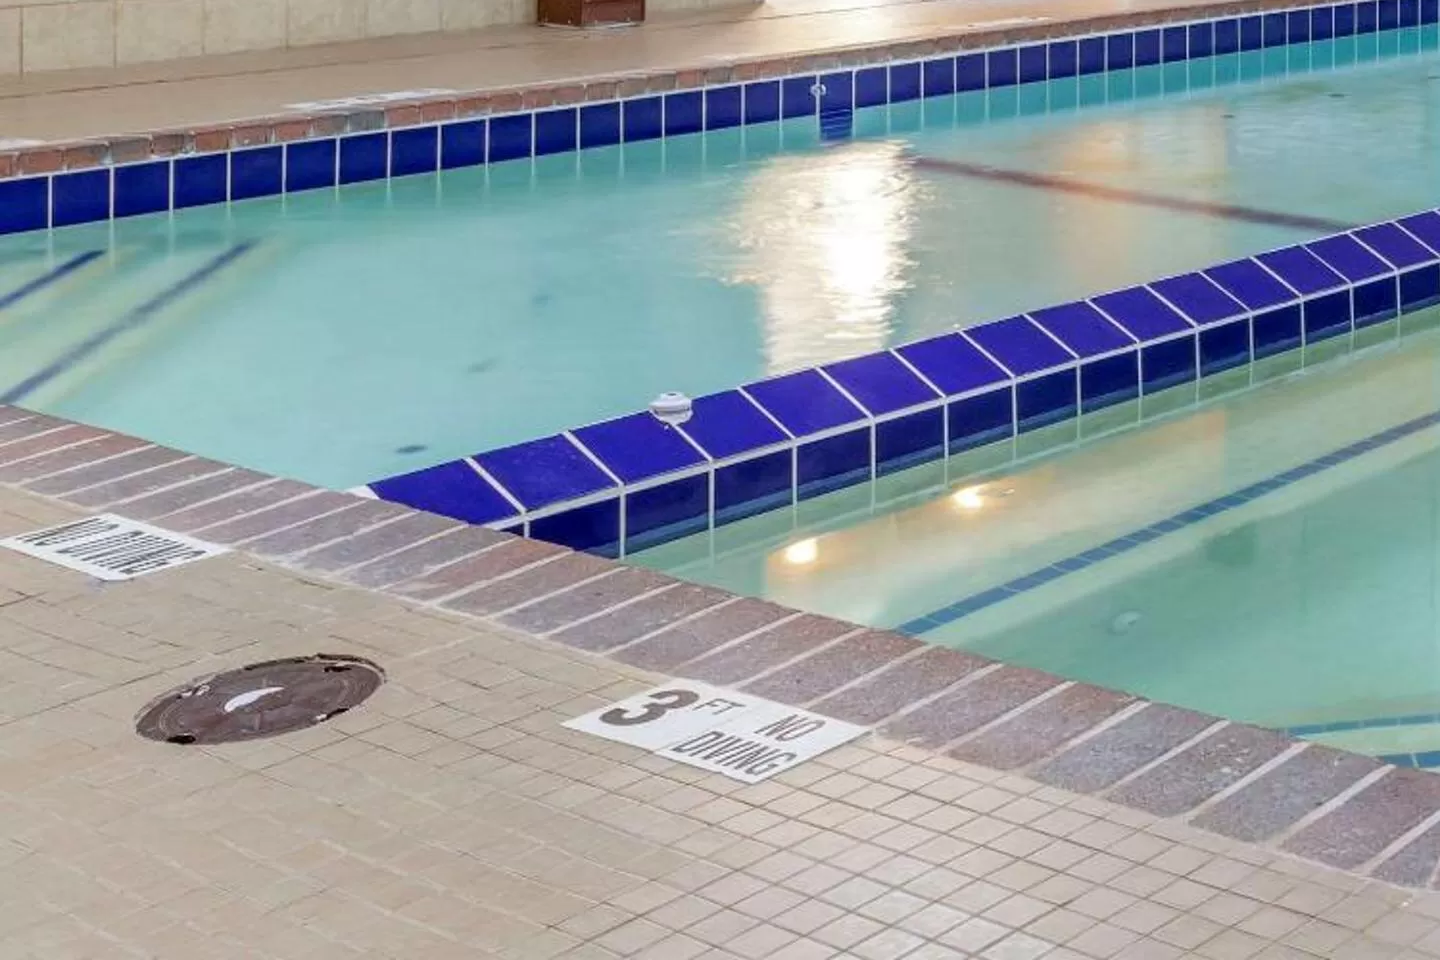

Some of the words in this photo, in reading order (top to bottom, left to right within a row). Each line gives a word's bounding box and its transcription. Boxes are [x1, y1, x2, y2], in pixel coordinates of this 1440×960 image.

[599, 689, 700, 727] 3
[692, 698, 746, 716] FT
[753, 714, 827, 742] NO
[671, 730, 798, 776] DIVING
